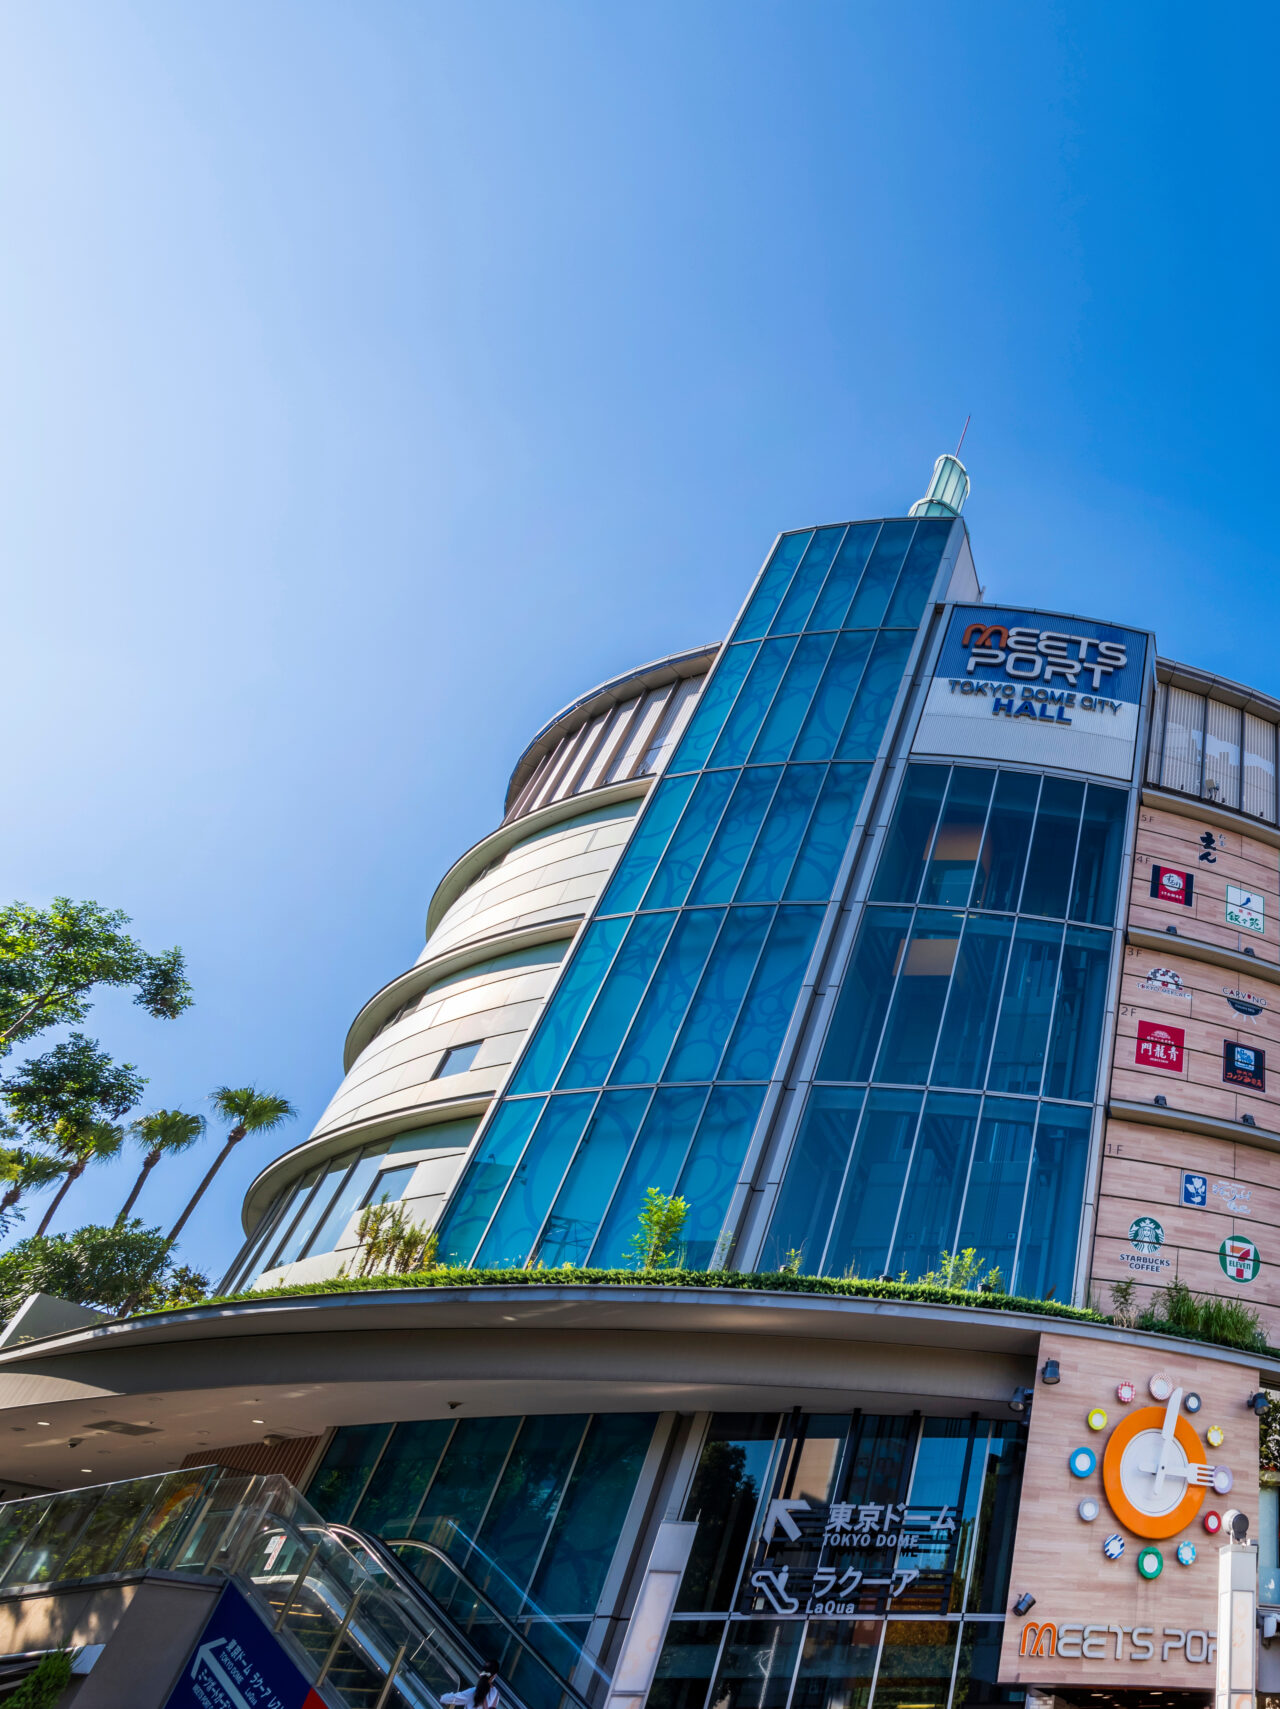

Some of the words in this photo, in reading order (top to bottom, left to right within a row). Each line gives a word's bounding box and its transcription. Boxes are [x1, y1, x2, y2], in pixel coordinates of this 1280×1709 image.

[962, 623, 1127, 668] MEETS
[966, 648, 1114, 690] PORT
[948, 679, 1016, 698] TOKYO
[1021, 687, 1076, 708] DOME
[1080, 695, 1123, 716] CITY
[992, 698, 1072, 725] HALL
[1120, 1253, 1171, 1267] STARBUCKS
[1129, 1262, 1161, 1273] COFFEE
[824, 1501, 957, 1534] 東京ドーム
[823, 1533, 870, 1548] TOKYO
[875, 1534, 919, 1548] DOME
[812, 1566, 920, 1598] ラクーア
[805, 1599, 855, 1616] LaQua
[1019, 1621, 1154, 1661] MEETS
[219, 1651, 234, 1671] TOKYO
